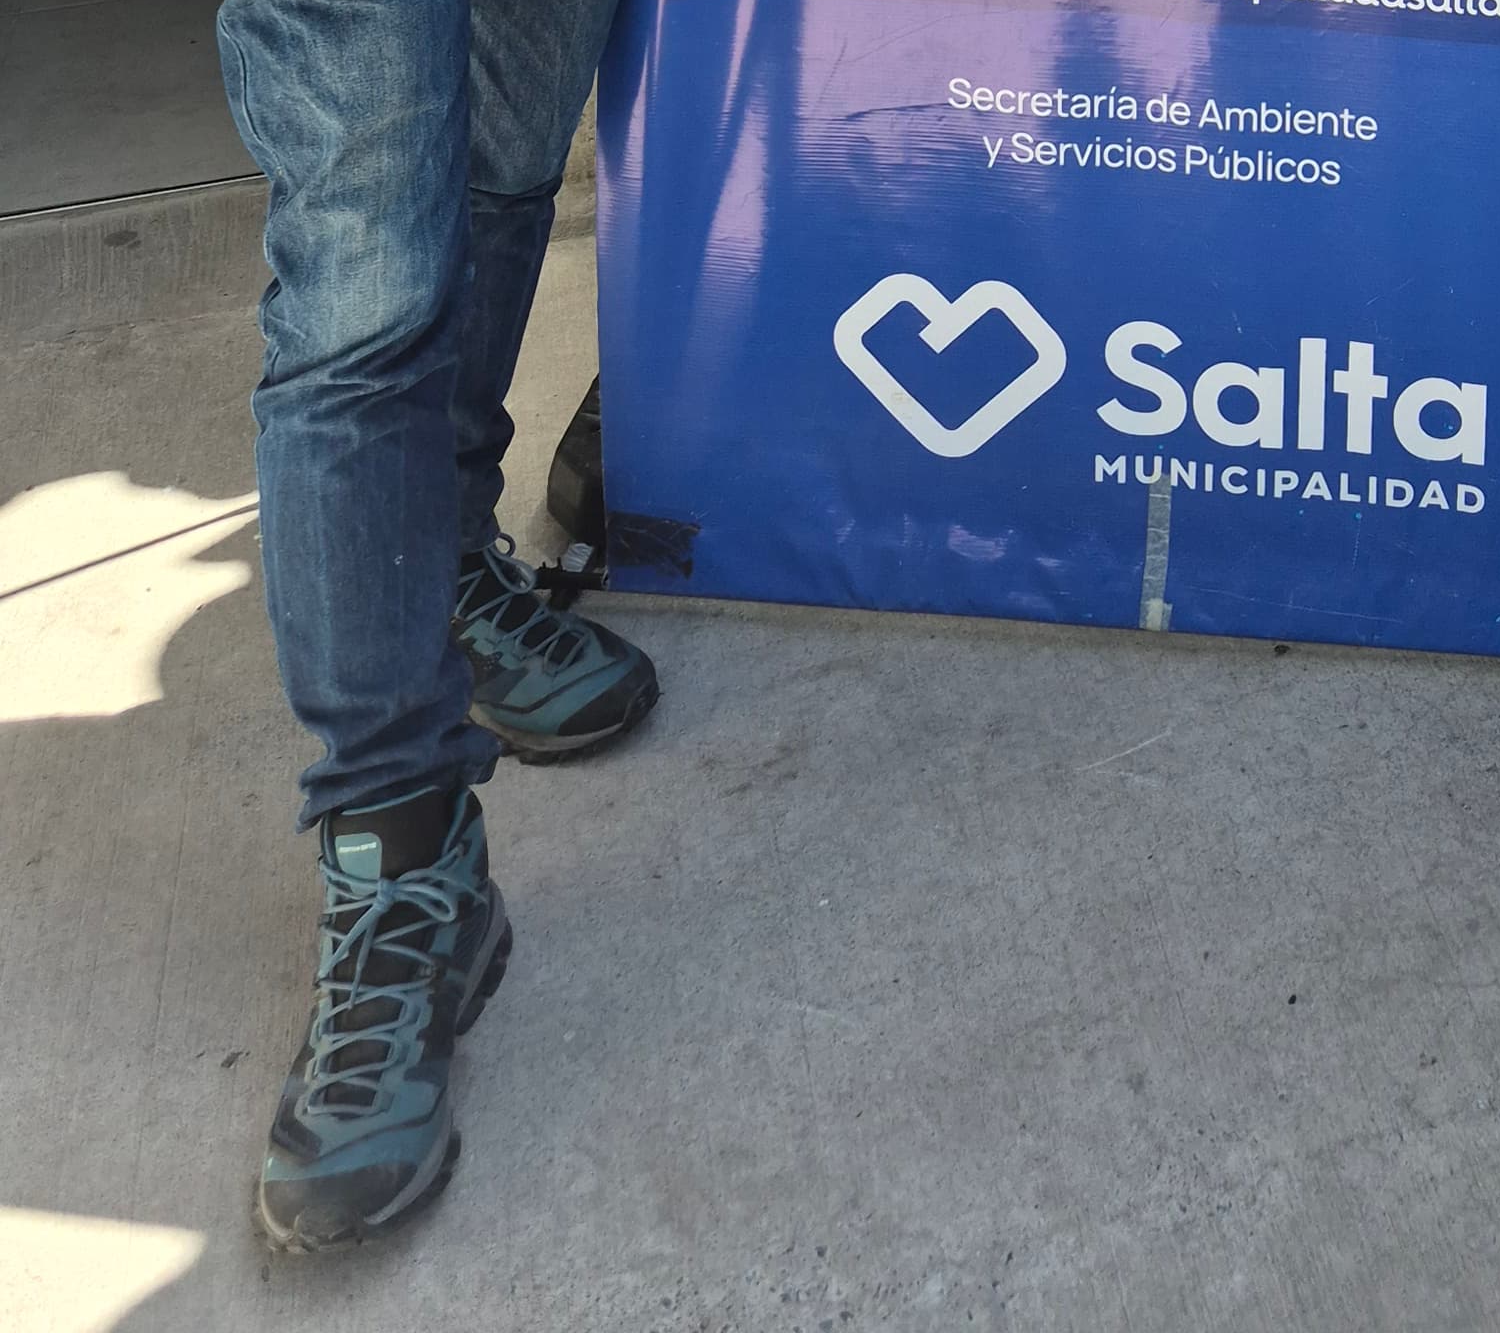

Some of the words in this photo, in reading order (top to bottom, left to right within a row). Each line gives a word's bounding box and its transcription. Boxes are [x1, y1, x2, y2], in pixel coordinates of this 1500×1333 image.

[947, 77, 1137, 121] Secretaría
[1145, 93, 1191, 126] de
[1198, 98, 1378, 141] Ambiente
[982, 135, 1003, 169] y
[1010, 132, 1177, 174] Servicios
[1184, 143, 1341, 185] Públicos
[1096, 320, 1488, 466] Salta
[1094, 453, 1486, 514] MUNICIPALIDAD
